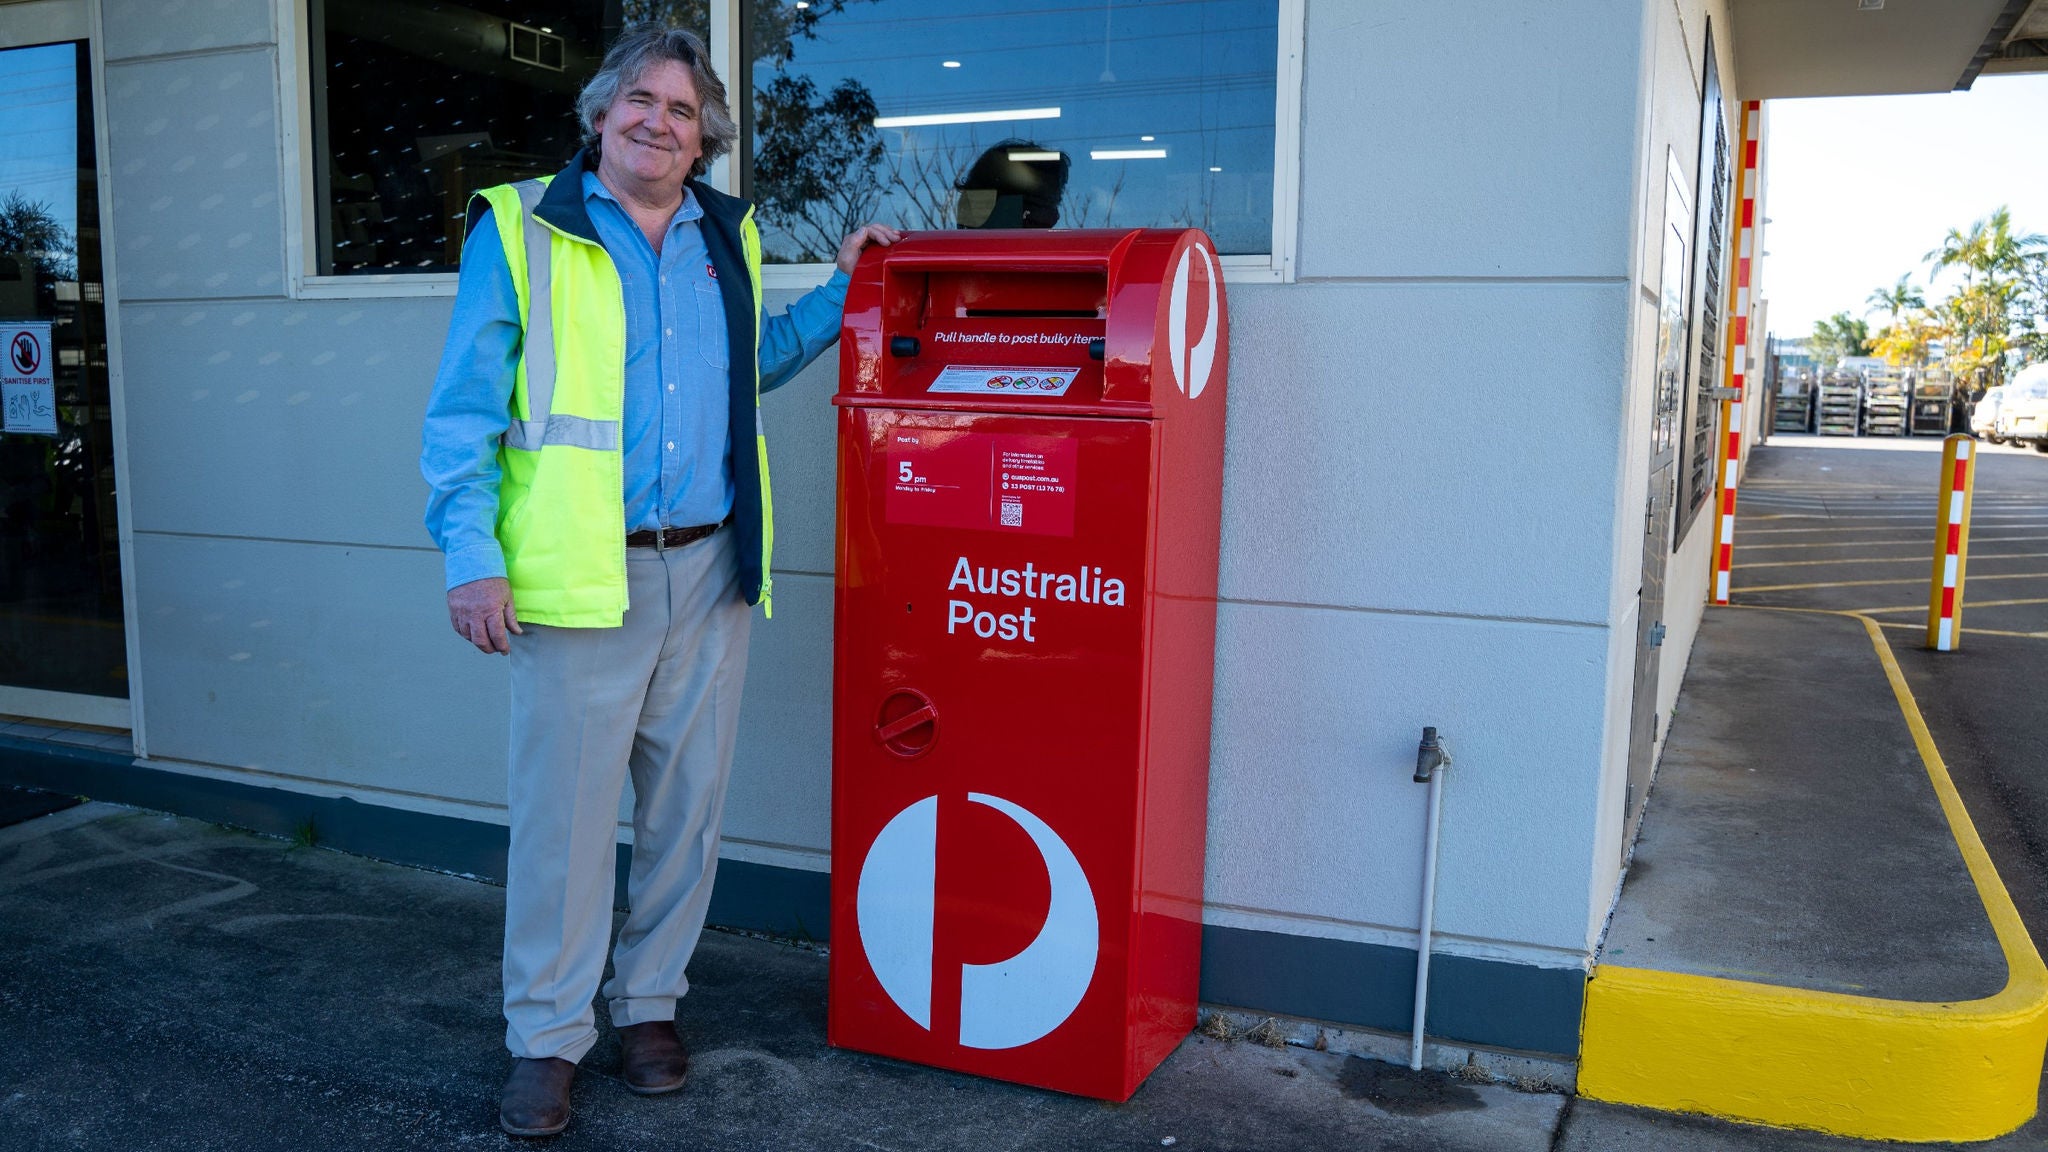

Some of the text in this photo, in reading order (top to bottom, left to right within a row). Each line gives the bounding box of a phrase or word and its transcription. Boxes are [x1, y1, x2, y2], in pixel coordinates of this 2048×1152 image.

[934, 332, 956, 343] Pull
[958, 332, 997, 343] handle
[998, 334, 1010, 343] to
[1011, 334, 1037, 345] post
[1039, 333, 1072, 346] bulky
[898, 461, 913, 482] 5
[948, 556, 1125, 606] Australia
[948, 599, 1036, 643] Post
